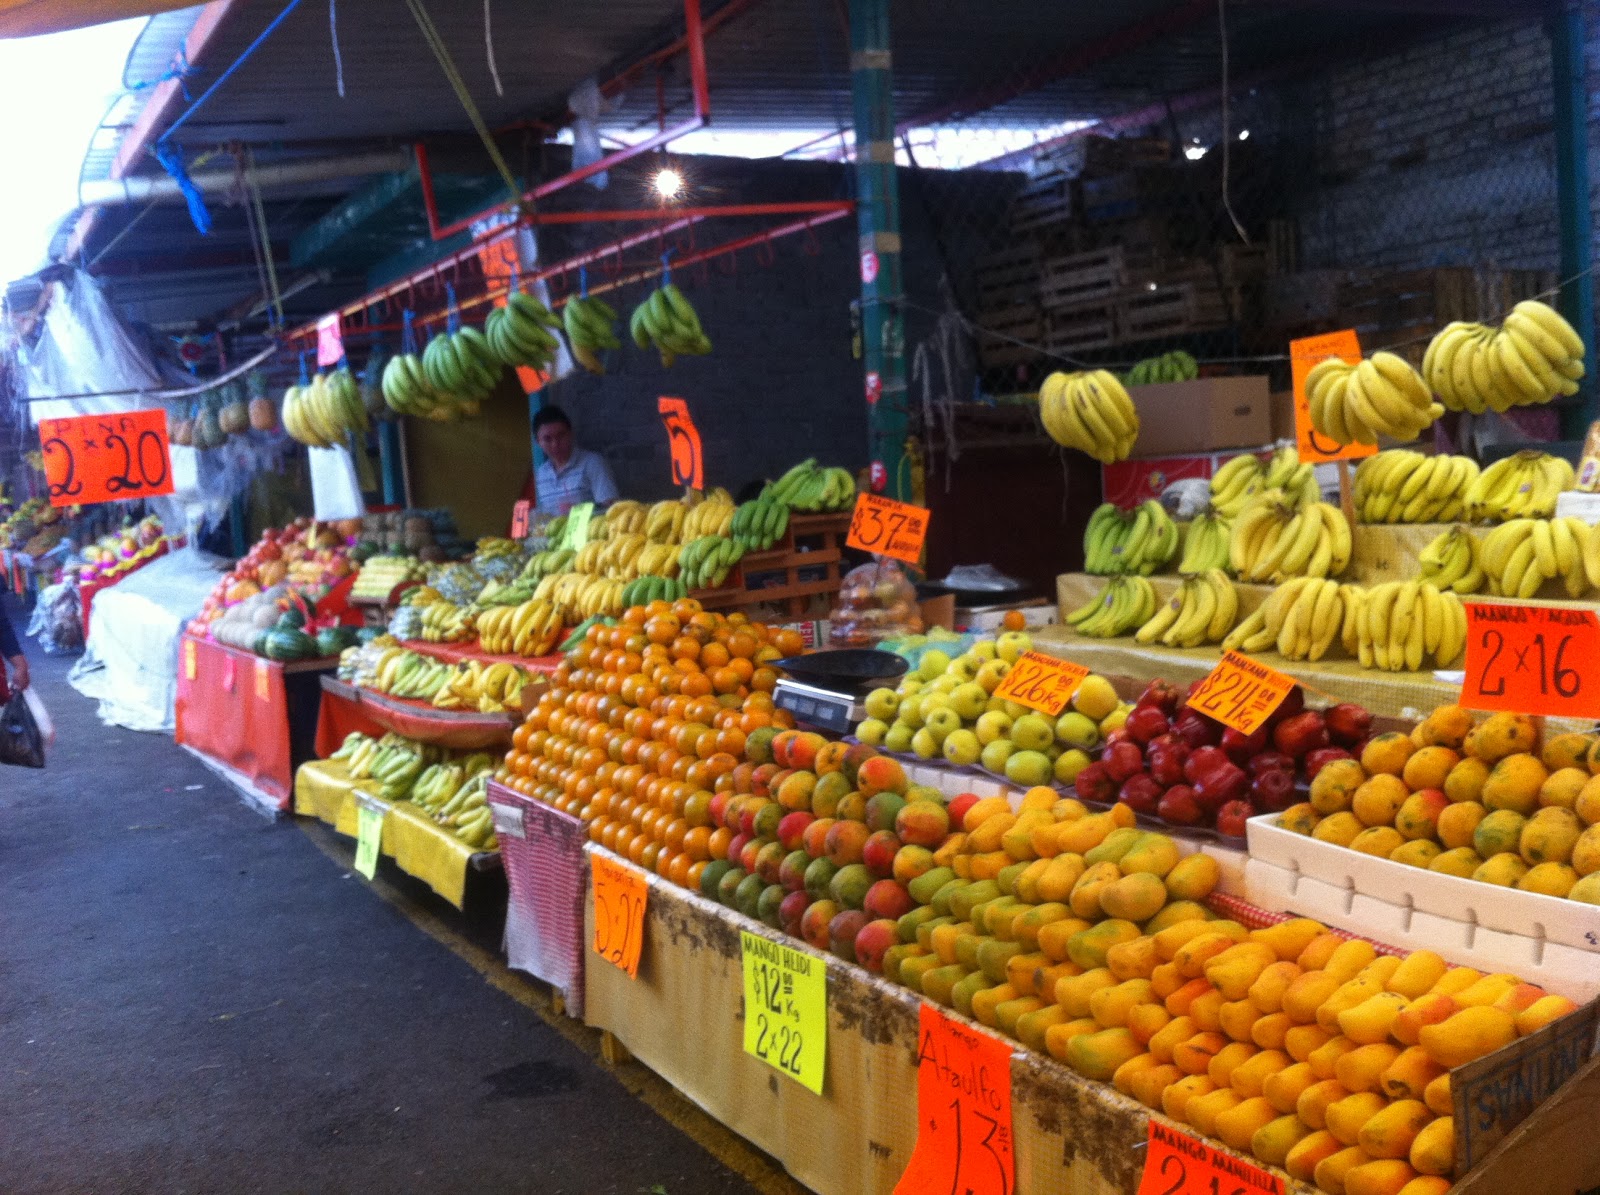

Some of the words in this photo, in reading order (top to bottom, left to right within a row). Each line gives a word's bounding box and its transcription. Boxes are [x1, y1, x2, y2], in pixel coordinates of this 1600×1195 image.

[744, 934, 780, 966] MANGO
[918, 1029, 1002, 1112] Ataulfo
[1153, 1124, 1207, 1162] MANGO
